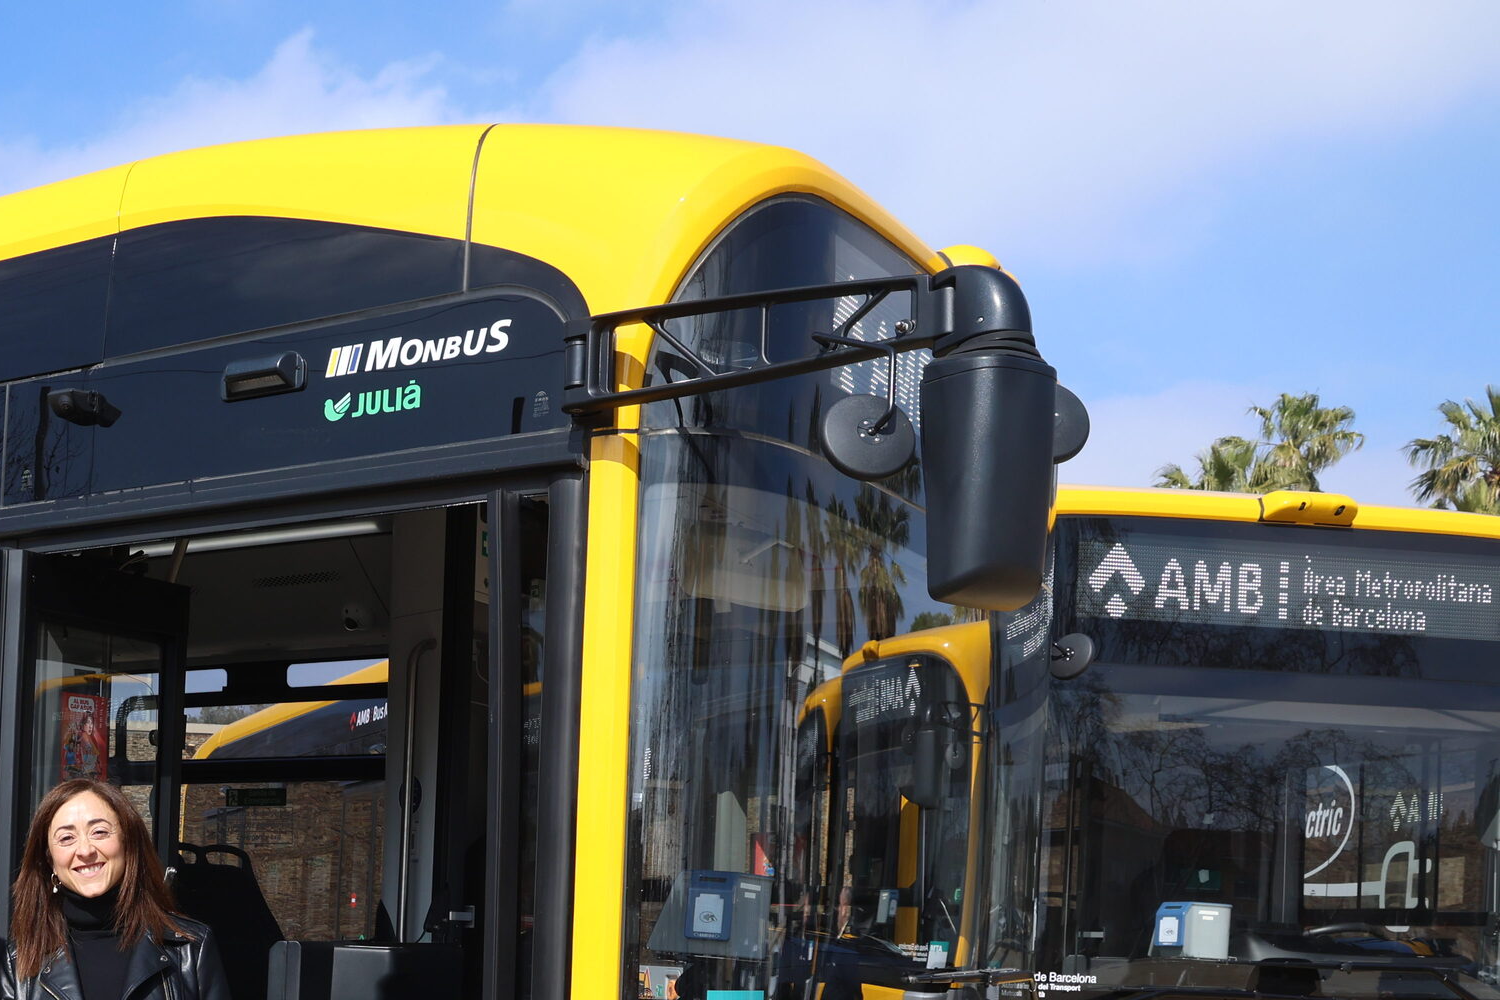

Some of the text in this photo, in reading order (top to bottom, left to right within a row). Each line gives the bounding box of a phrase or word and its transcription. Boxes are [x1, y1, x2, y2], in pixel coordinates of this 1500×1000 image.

[364, 319, 513, 372] MONBUS
[1155, 558, 1264, 614] AMB
[1303, 555, 1492, 604] Àrea Metropolitana
[1303, 598, 1426, 631] de Barcelona
[356, 708, 370, 726] AMB
[1305, 800, 1344, 839] ctric
[1034, 971, 1097, 984] de Barcelona
[1038, 983, 1048, 991] del
[1050, 983, 1081, 992] Transport
